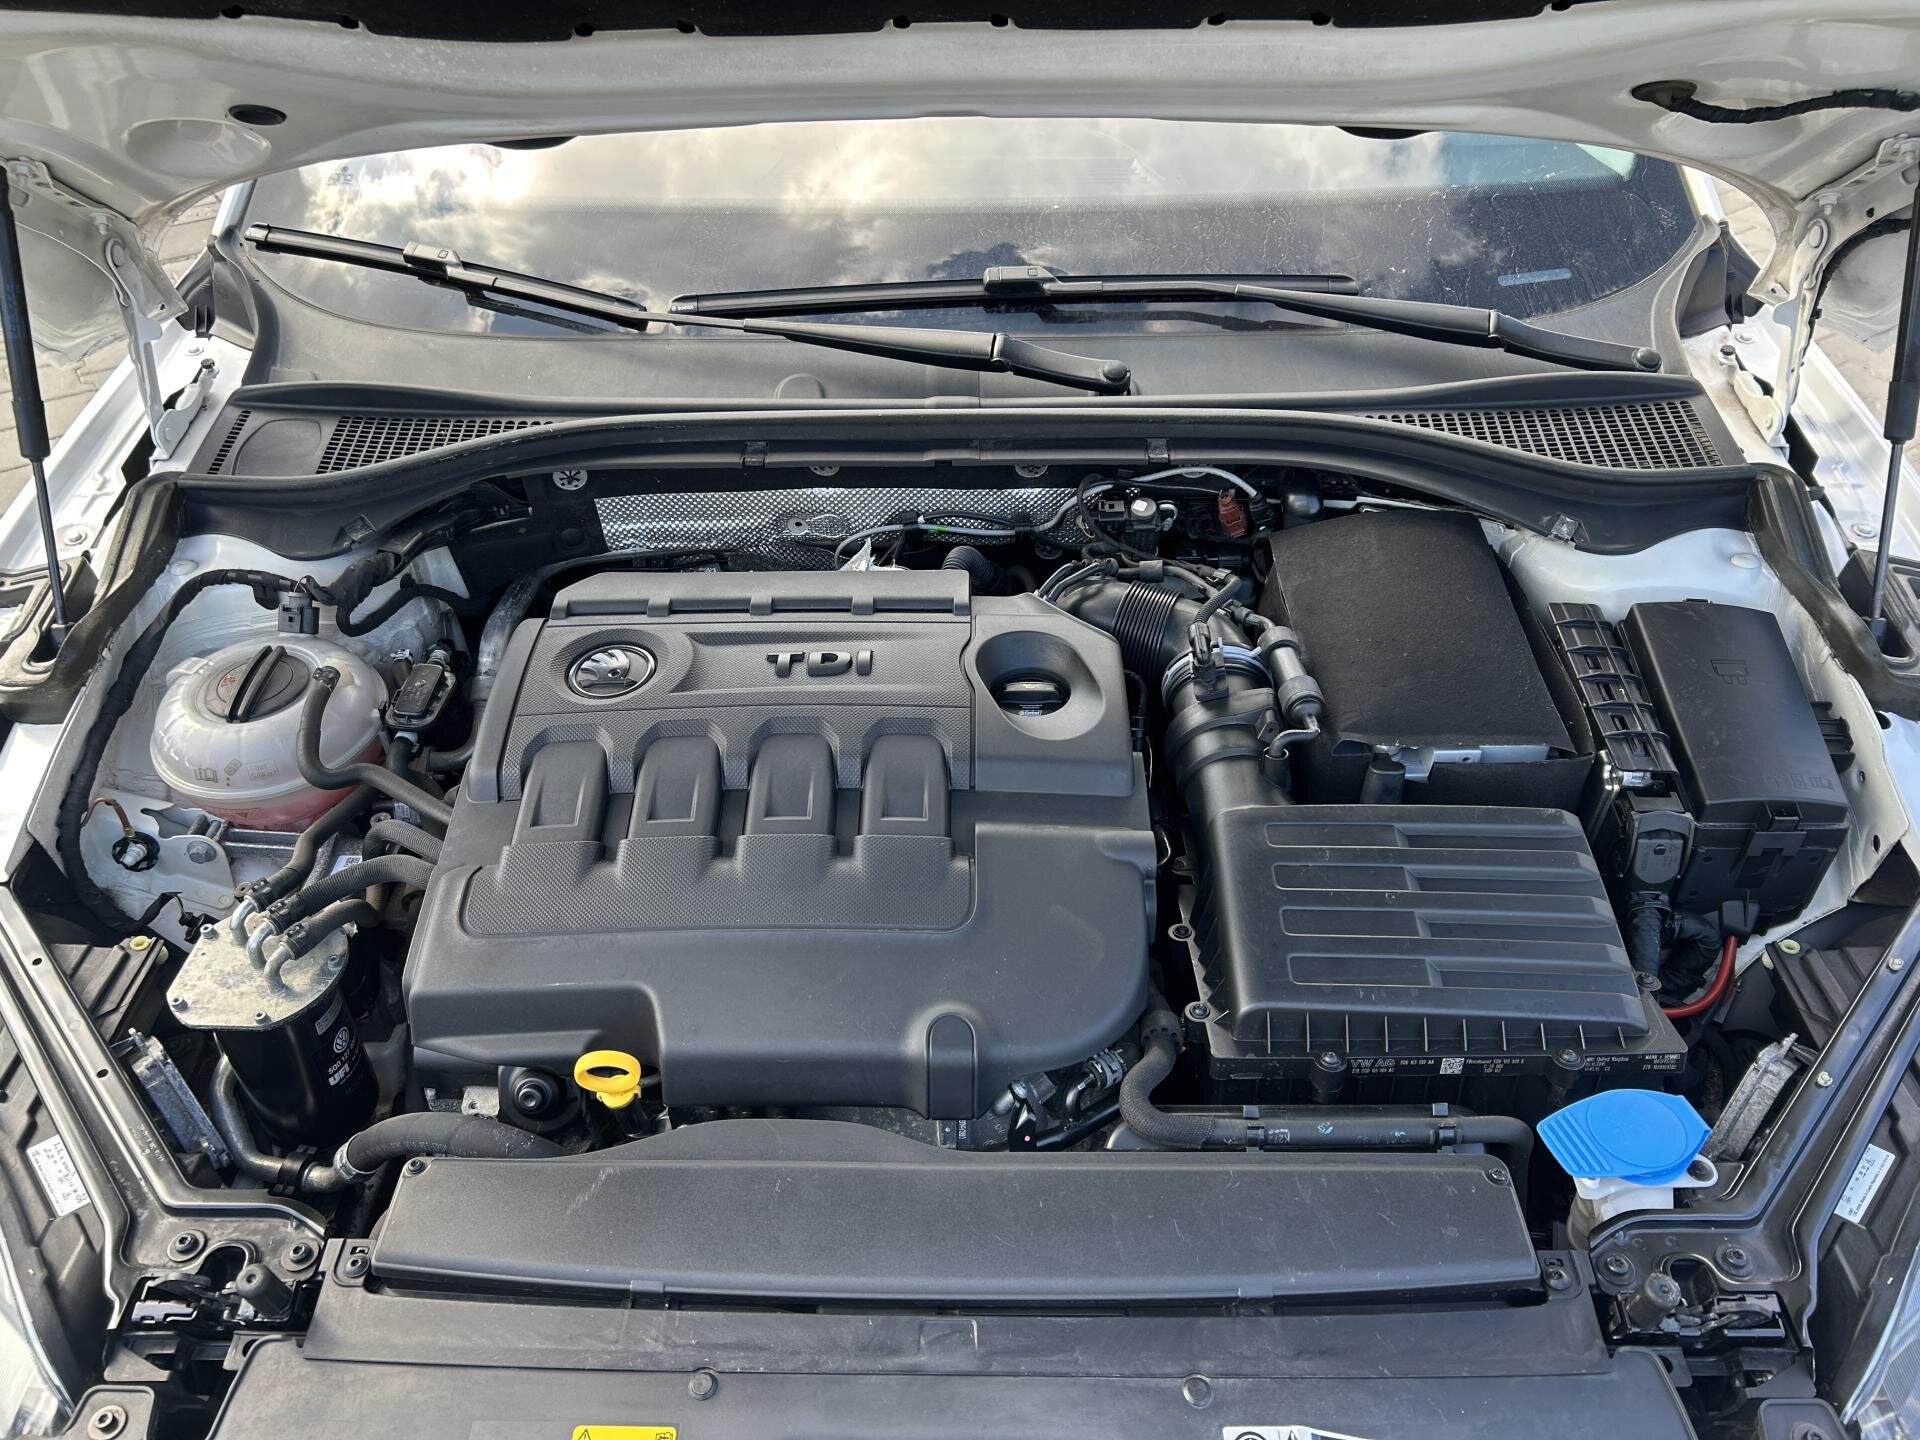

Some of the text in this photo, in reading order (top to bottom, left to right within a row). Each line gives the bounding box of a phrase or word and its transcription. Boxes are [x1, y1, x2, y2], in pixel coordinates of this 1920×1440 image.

[766, 649, 874, 678] TDI
[328, 1062, 350, 1086] UFI
[1351, 1059, 1374, 1068] VW
[1375, 1058, 1396, 1068] AG
